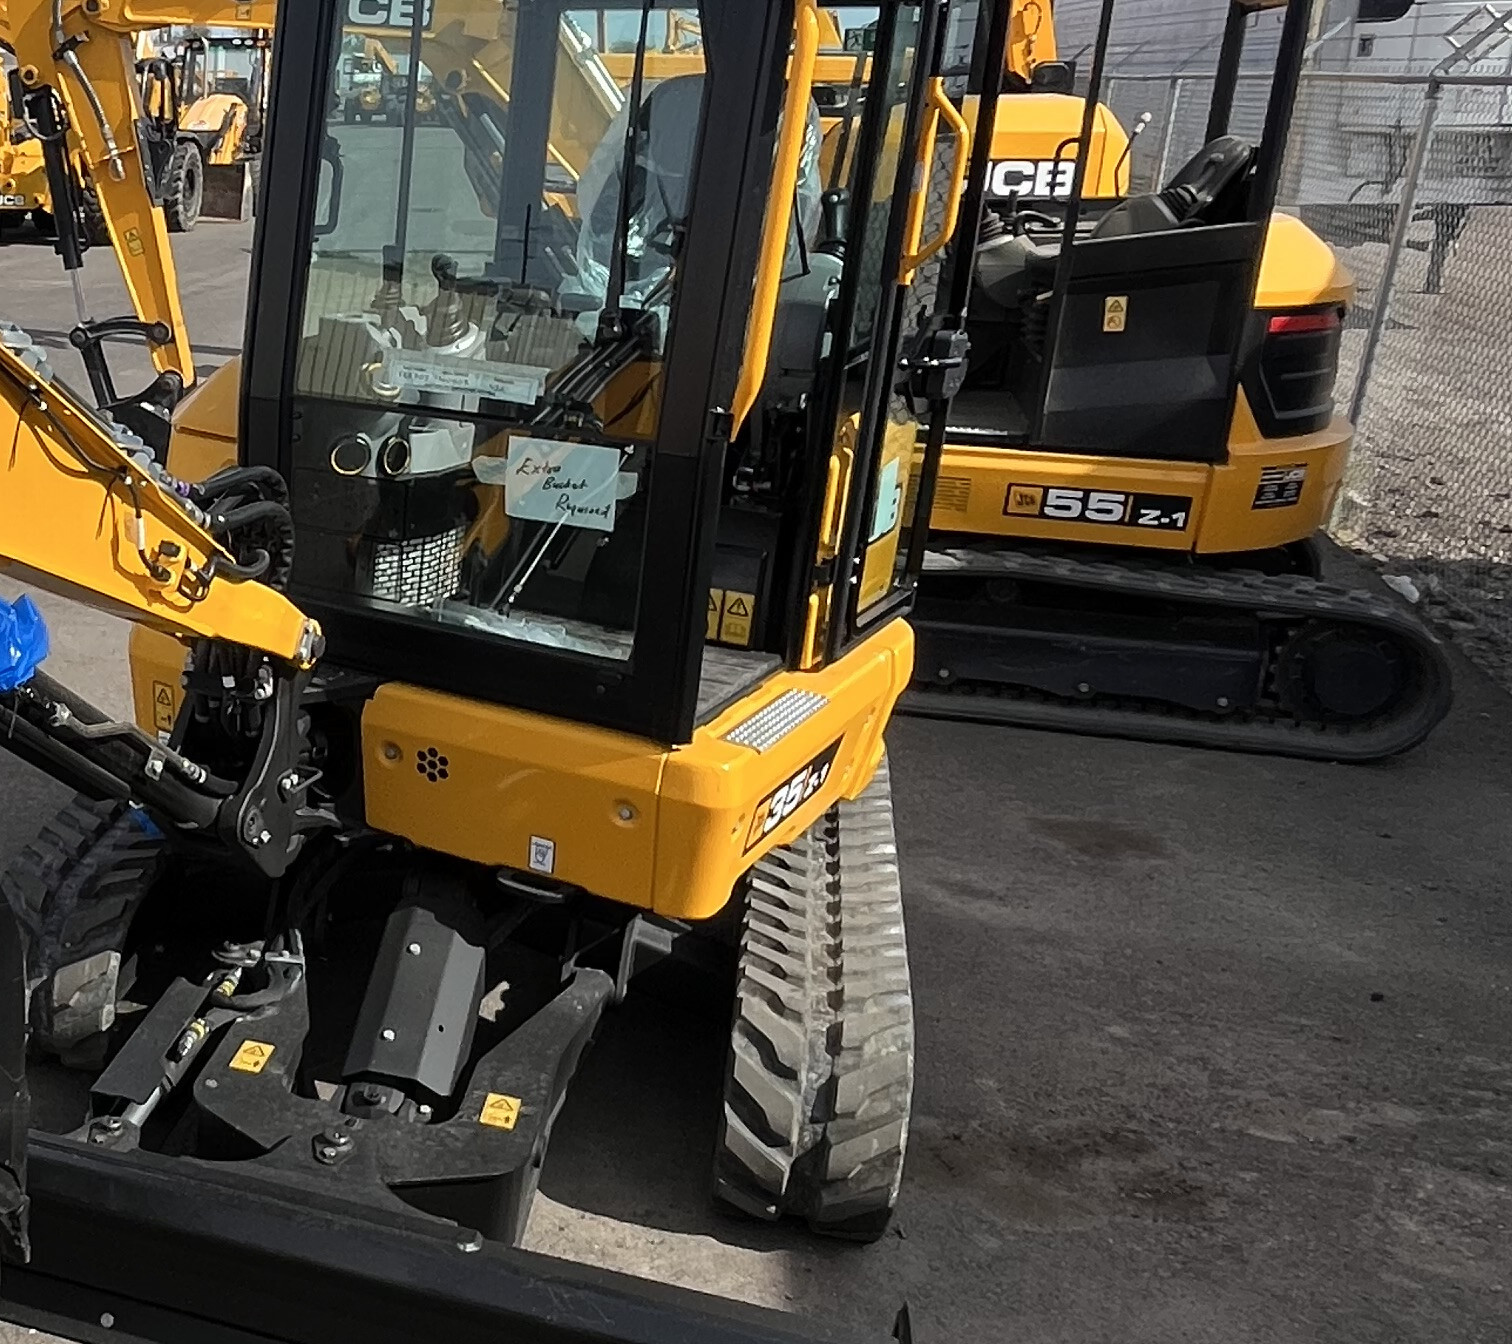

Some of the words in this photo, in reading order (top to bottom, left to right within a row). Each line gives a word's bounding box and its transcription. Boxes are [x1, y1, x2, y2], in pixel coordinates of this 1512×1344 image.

[516, 457, 562, 476] Extra
[1043, 488, 1126, 522] 55
[1138, 508, 1186, 527] Z-1
